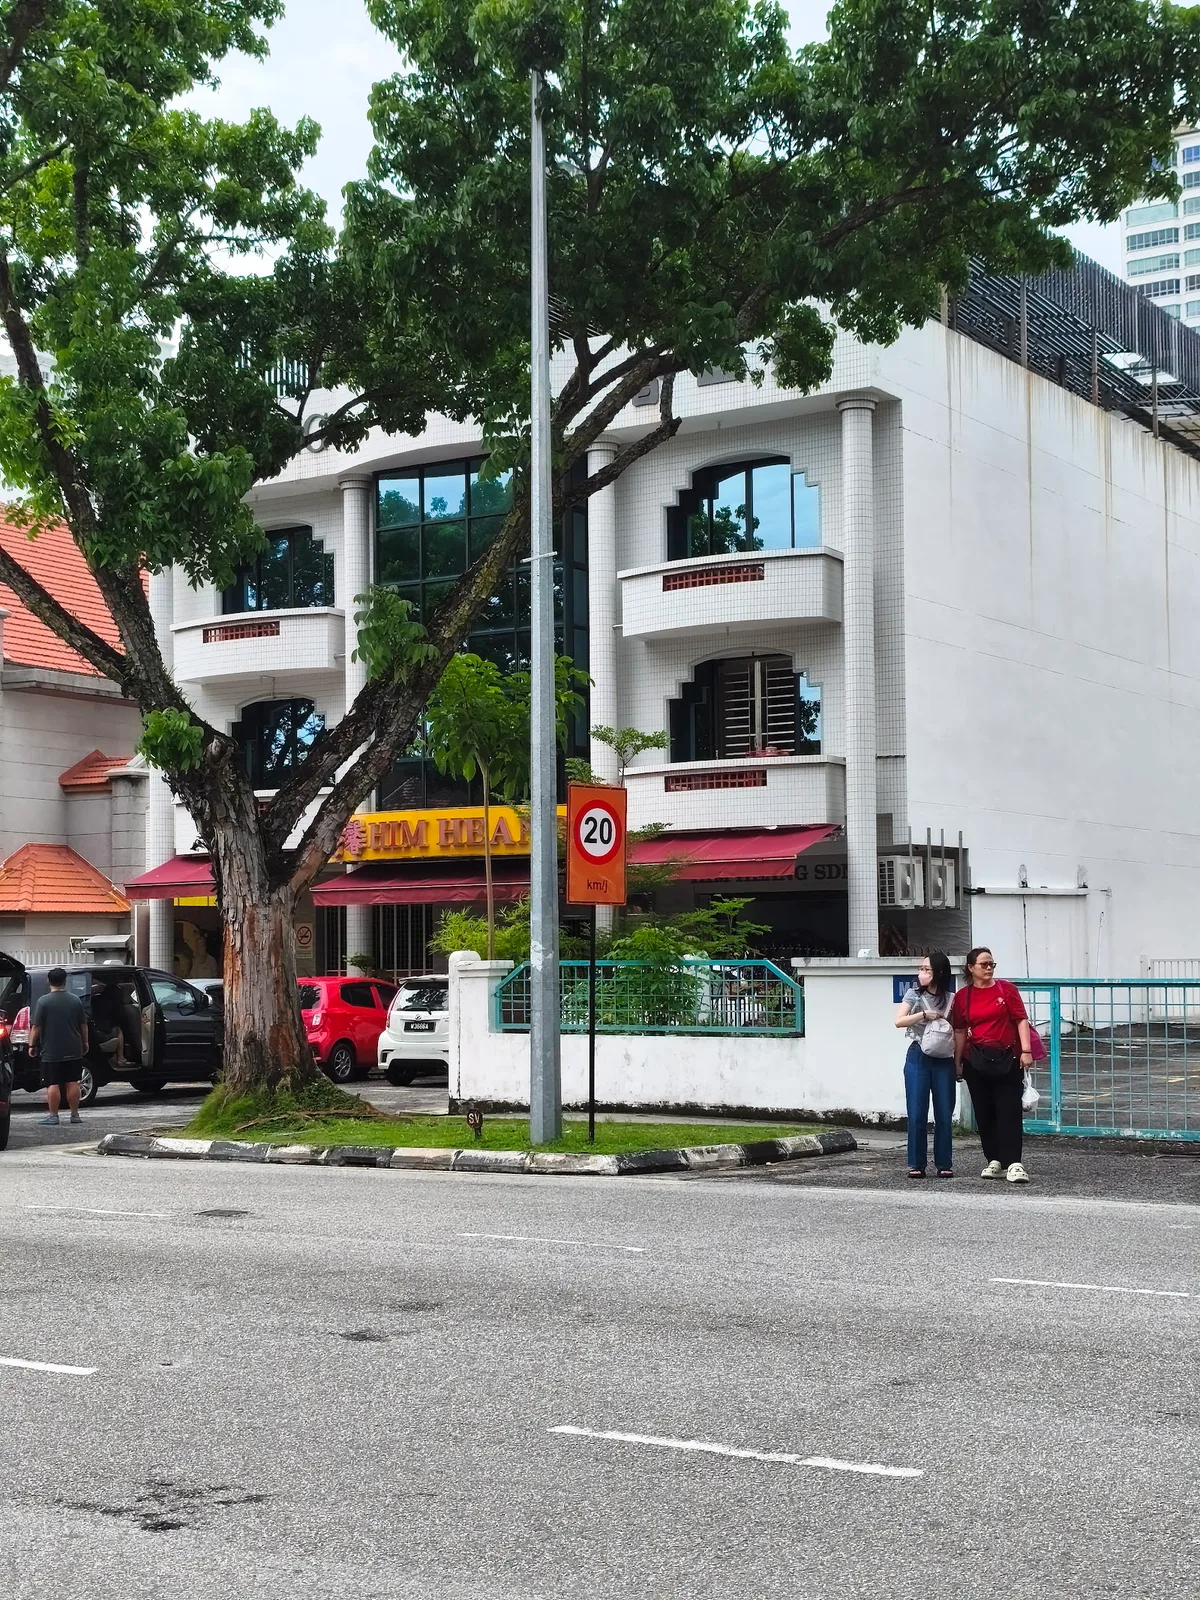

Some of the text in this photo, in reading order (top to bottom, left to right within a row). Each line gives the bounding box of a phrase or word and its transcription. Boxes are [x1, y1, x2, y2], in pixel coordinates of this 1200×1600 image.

[368, 819, 429, 850] HIM
[583, 816, 613, 845] 20
[586, 879, 608, 893] km/j
[468, 1112, 480, 1124] SV
